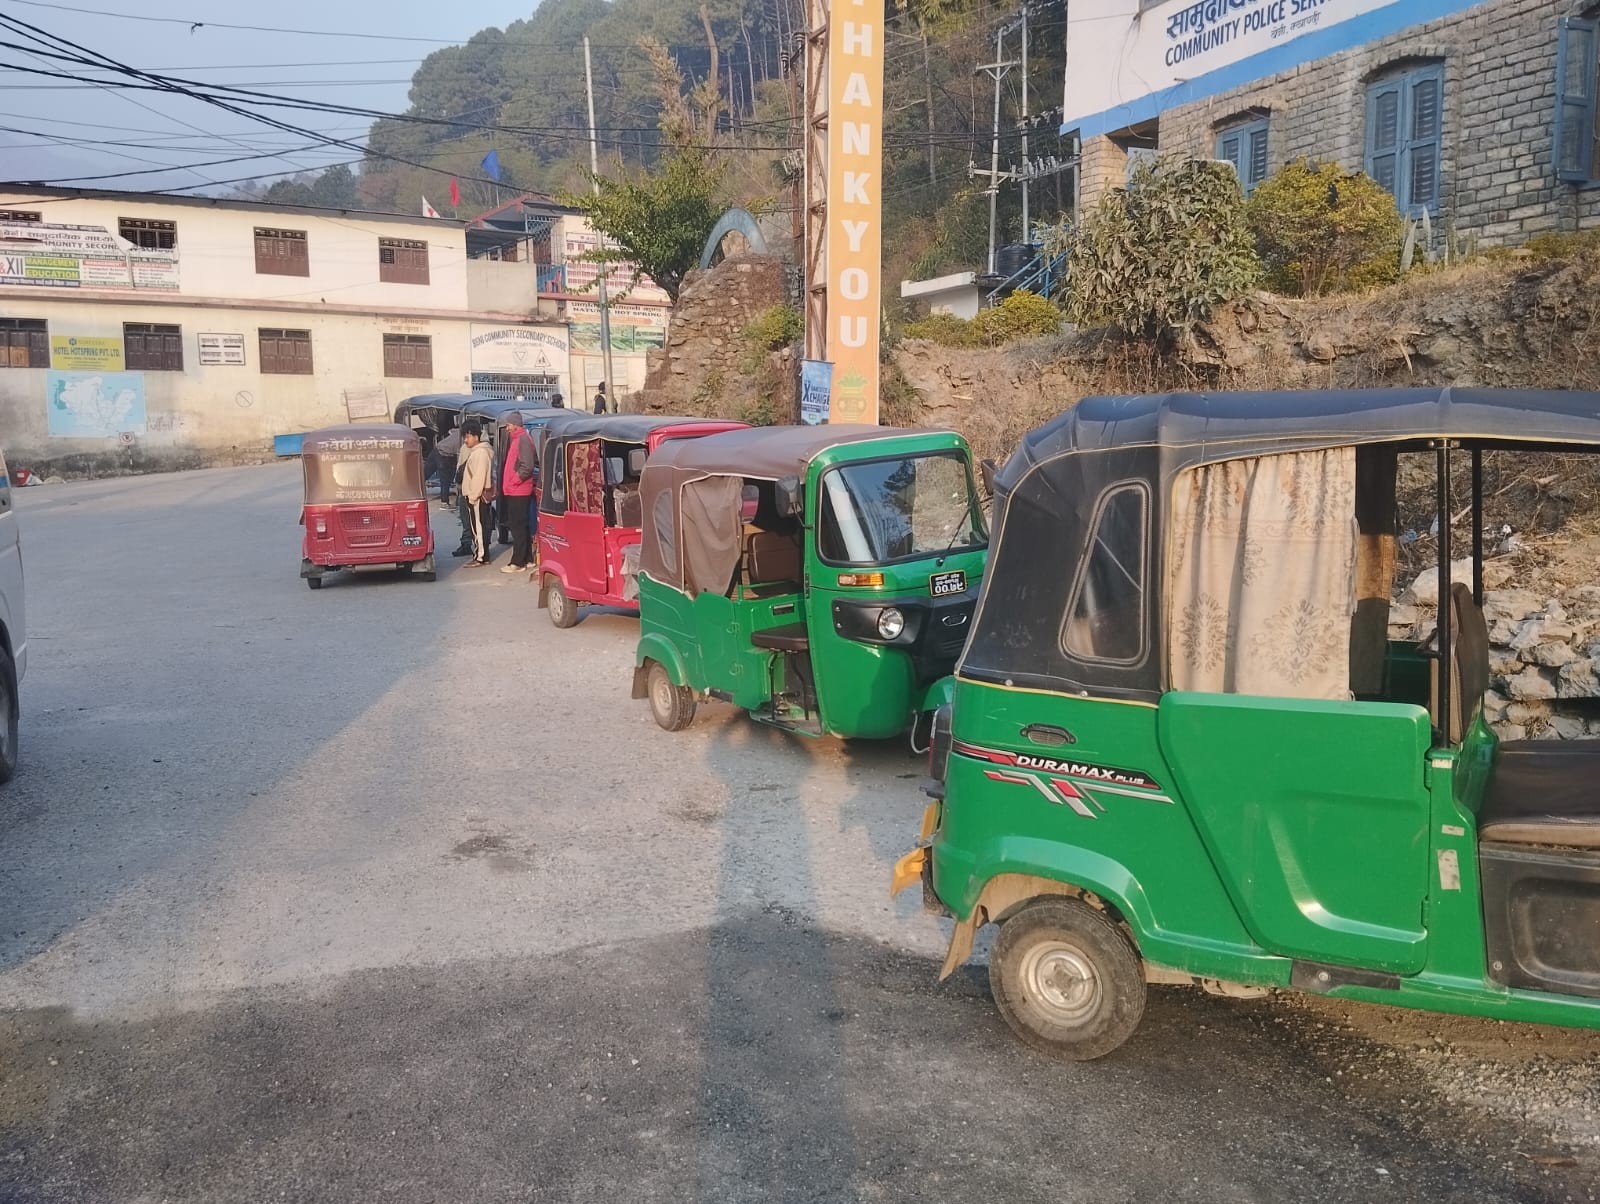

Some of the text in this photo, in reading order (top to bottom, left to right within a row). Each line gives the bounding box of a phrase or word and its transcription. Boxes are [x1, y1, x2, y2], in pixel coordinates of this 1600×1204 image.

[1165, 17, 1240, 67] COMMUNITY
[1243, 0, 1286, 35] POLICE
[7, 257, 23, 275] XII
[26, 258, 79, 268] MANAGEMENT
[27, 269, 78, 278] EDUCATION
[485, 330, 515, 342] COMMUNITY
[517, 329, 546, 341] SECONDARY
[547, 335, 567, 352] SCHOOL
[54, 346, 69, 355] HOTEL
[1017, 755, 1145, 785] DURAMAX PLUS
